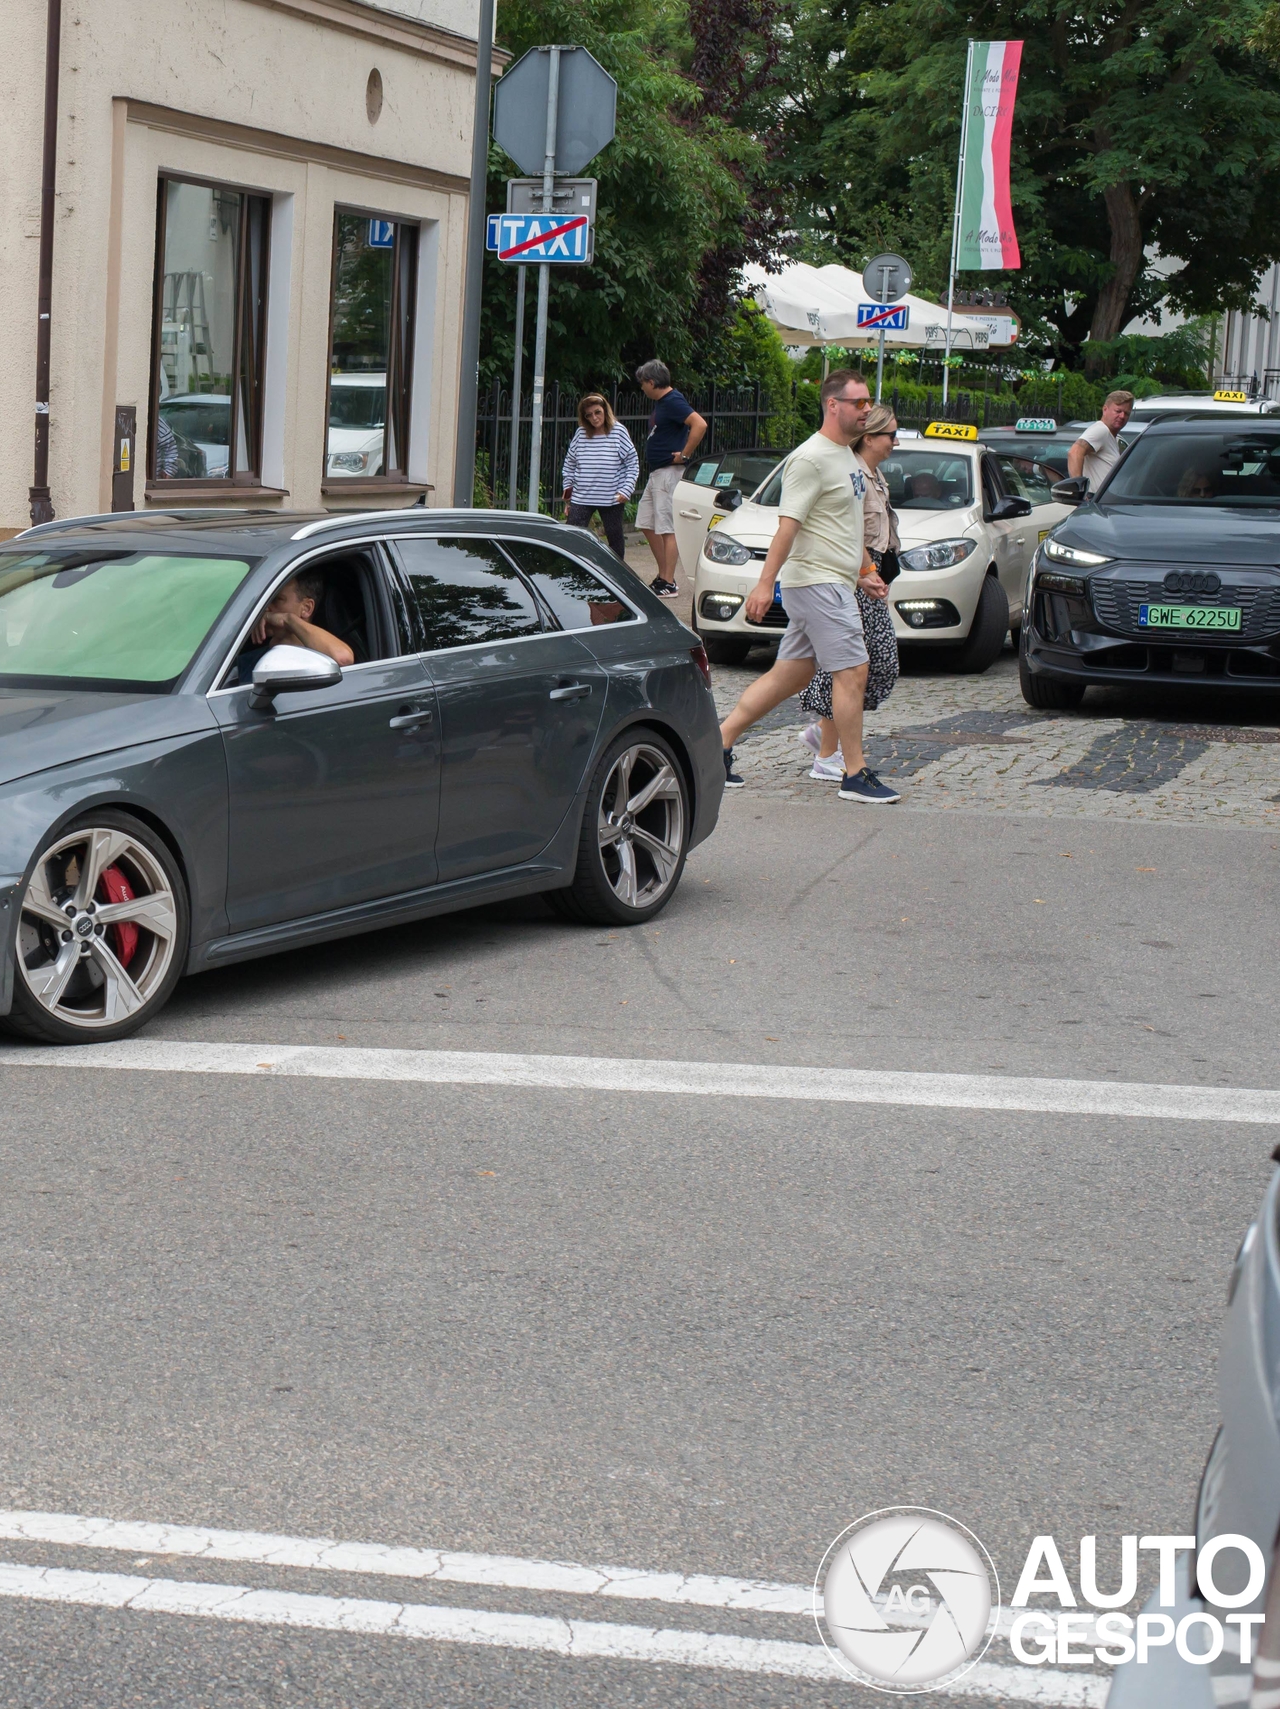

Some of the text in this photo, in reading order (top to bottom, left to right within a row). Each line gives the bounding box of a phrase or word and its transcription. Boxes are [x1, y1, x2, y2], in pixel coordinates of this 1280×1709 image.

[503, 220, 582, 256] TAXI
[859, 307, 903, 327] TAXI
[933, 427, 970, 437] TAXI
[1149, 608, 1238, 627] GWE 6225U
